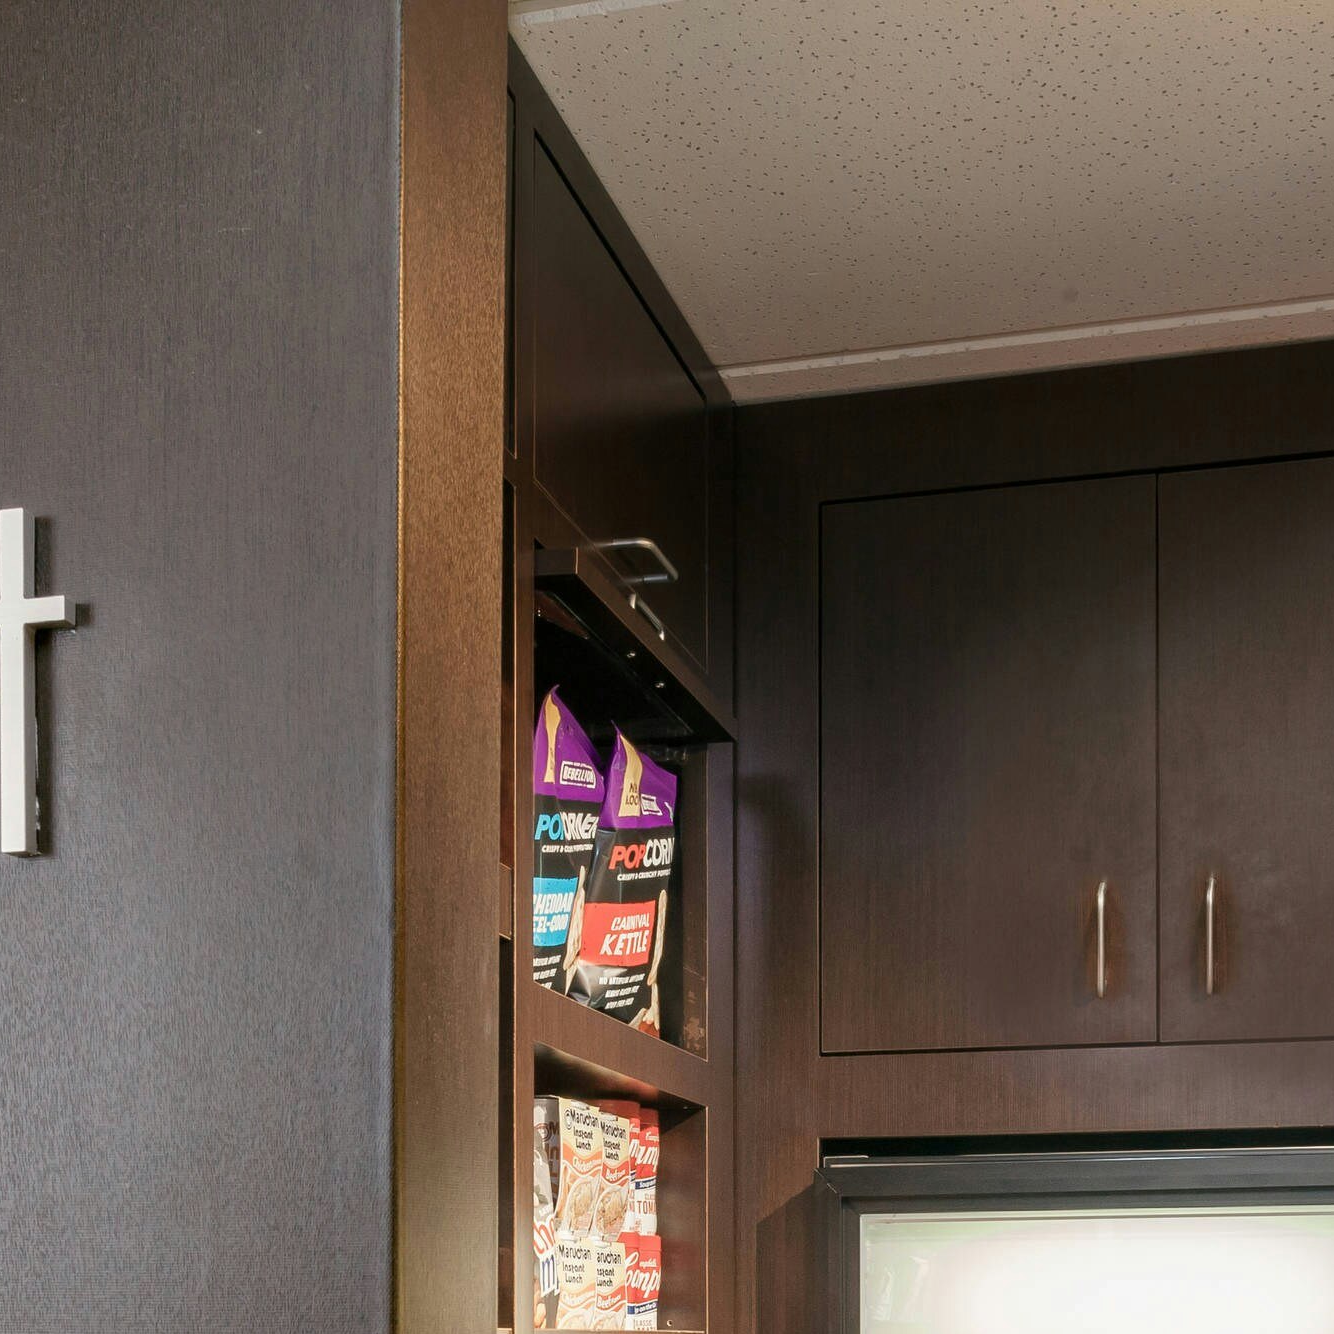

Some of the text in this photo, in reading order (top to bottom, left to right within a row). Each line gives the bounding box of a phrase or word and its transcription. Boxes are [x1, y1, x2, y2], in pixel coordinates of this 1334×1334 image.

[610, 913, 649, 931] CARNIVAL
[599, 930, 649, 956] KETTLE
[570, 1108, 599, 1129] Maruchan
[573, 1126, 594, 1140] Instant
[601, 1120, 627, 1140] Maruchan
[575, 1138, 592, 1151] Lunch
[605, 1149, 620, 1161] Lunch
[558, 1244, 592, 1261] Maruchan
[562, 1263, 585, 1274] Instant
[565, 1274, 583, 1284] Lunch
